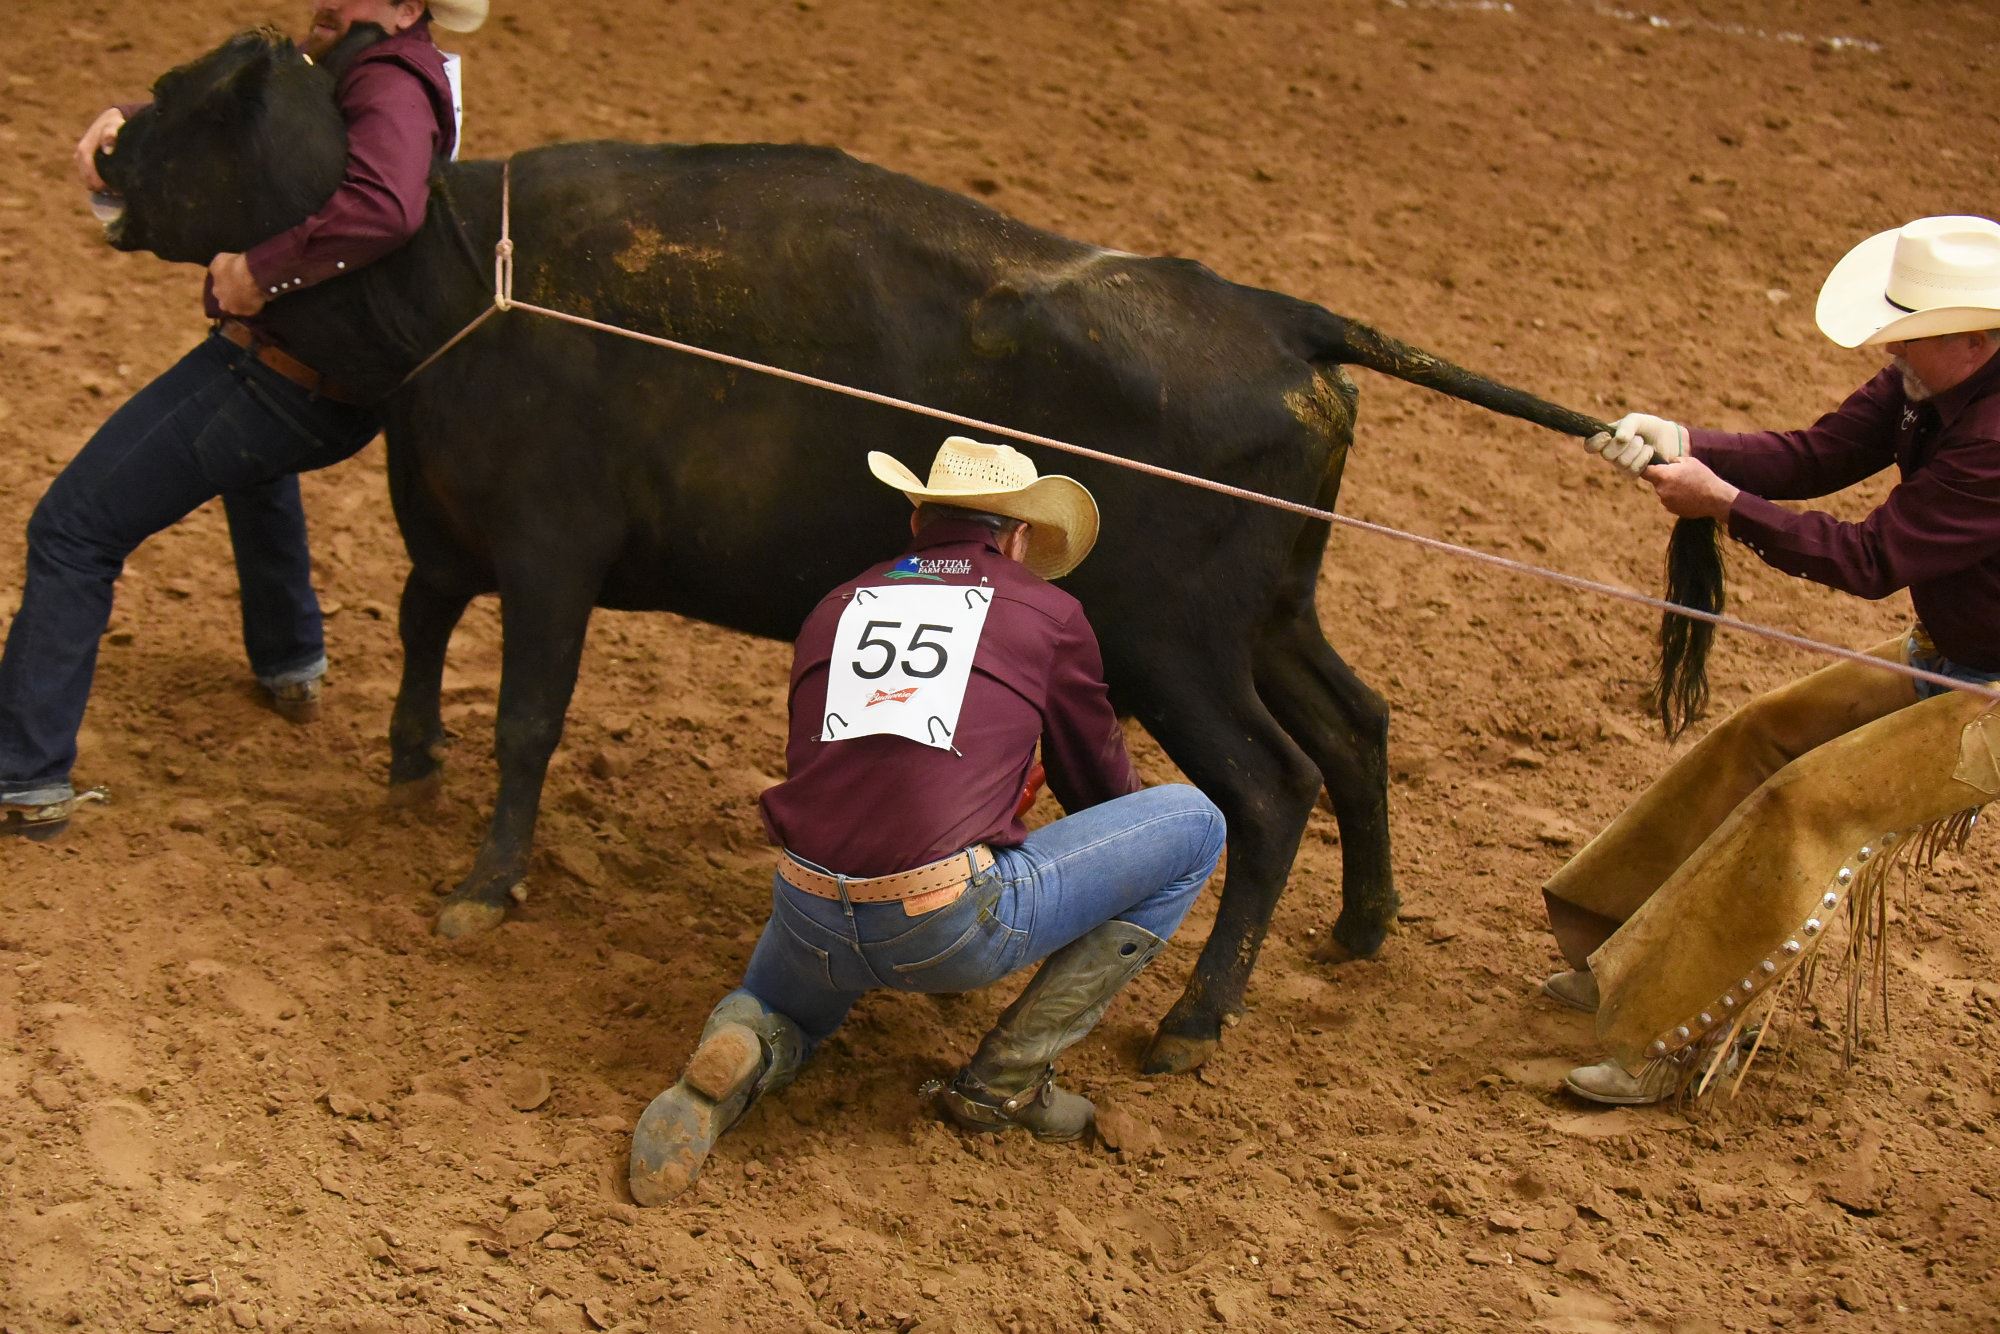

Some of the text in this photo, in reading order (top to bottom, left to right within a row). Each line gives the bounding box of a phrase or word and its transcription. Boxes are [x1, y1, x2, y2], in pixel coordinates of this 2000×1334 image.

[919, 559, 972, 568] CAPITAL
[941, 567, 971, 575] CREDIT
[851, 620, 953, 679] 55
